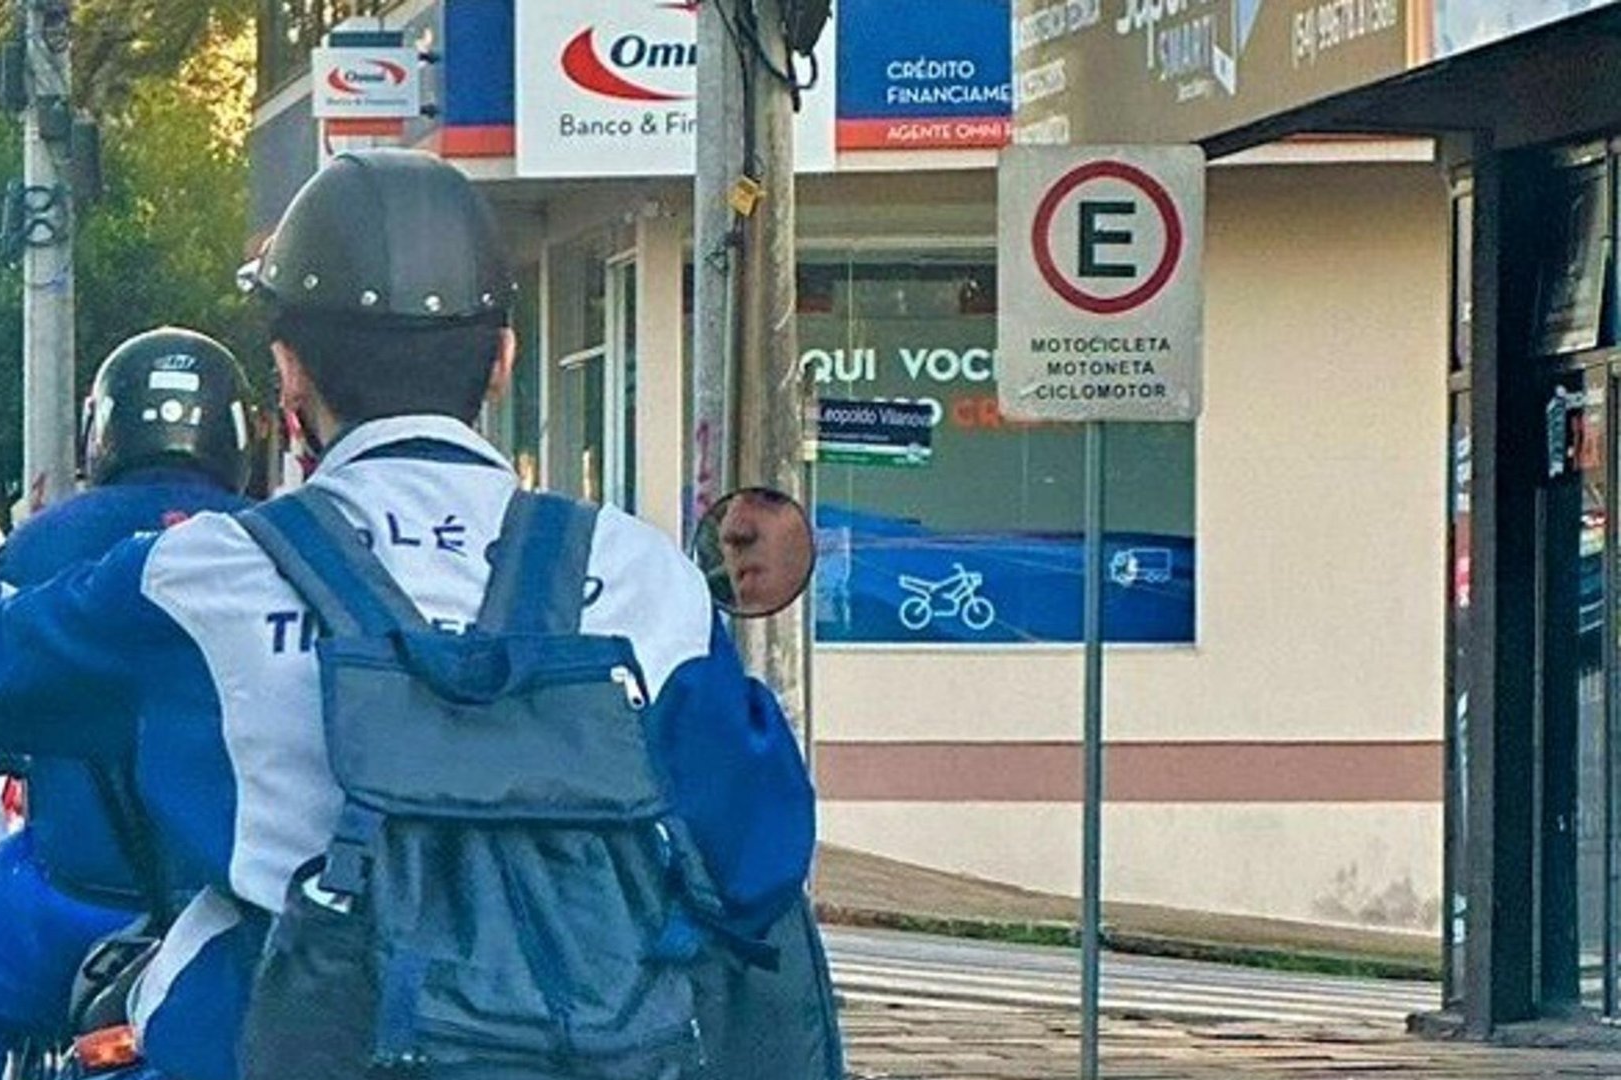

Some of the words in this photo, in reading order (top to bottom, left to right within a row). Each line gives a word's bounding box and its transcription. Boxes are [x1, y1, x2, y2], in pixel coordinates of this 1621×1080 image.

[887, 55, 975, 79] CRÉDITO
[560, 113, 633, 136] Banco
[640, 111, 657, 135] &
[887, 122, 952, 140] AGENTE
[956, 121, 1003, 139] OMNI
[1078, 201, 1137, 278] E
[1031, 337, 1171, 353] MOTOCICLETA
[1047, 360, 1155, 376] MOTONETA
[1035, 383, 1166, 400] CICLOMOTOR
